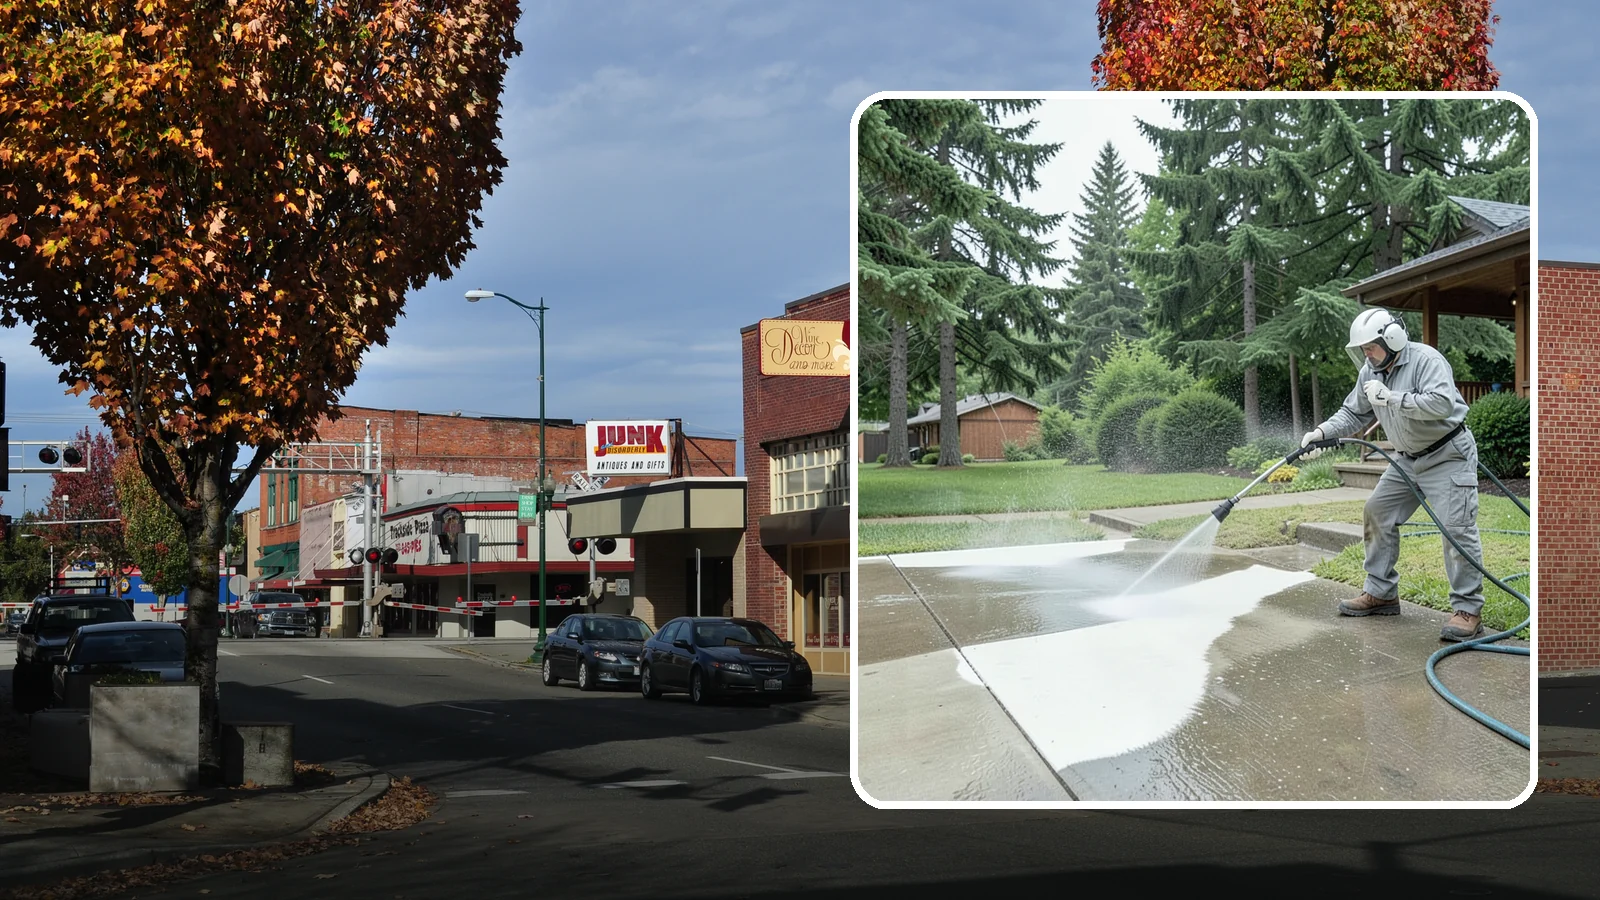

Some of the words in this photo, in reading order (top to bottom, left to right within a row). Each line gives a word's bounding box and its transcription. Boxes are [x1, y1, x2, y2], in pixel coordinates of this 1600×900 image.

[595, 425, 665, 457] JUNK
[607, 446, 646, 454] DISORDERLY
[596, 461, 628, 470] ANTIQUES
[631, 461, 644, 470] AND
[647, 460, 665, 469] GIFTS
[573, 473, 589, 492] RAIL
[414, 519, 429, 535] Pizza
